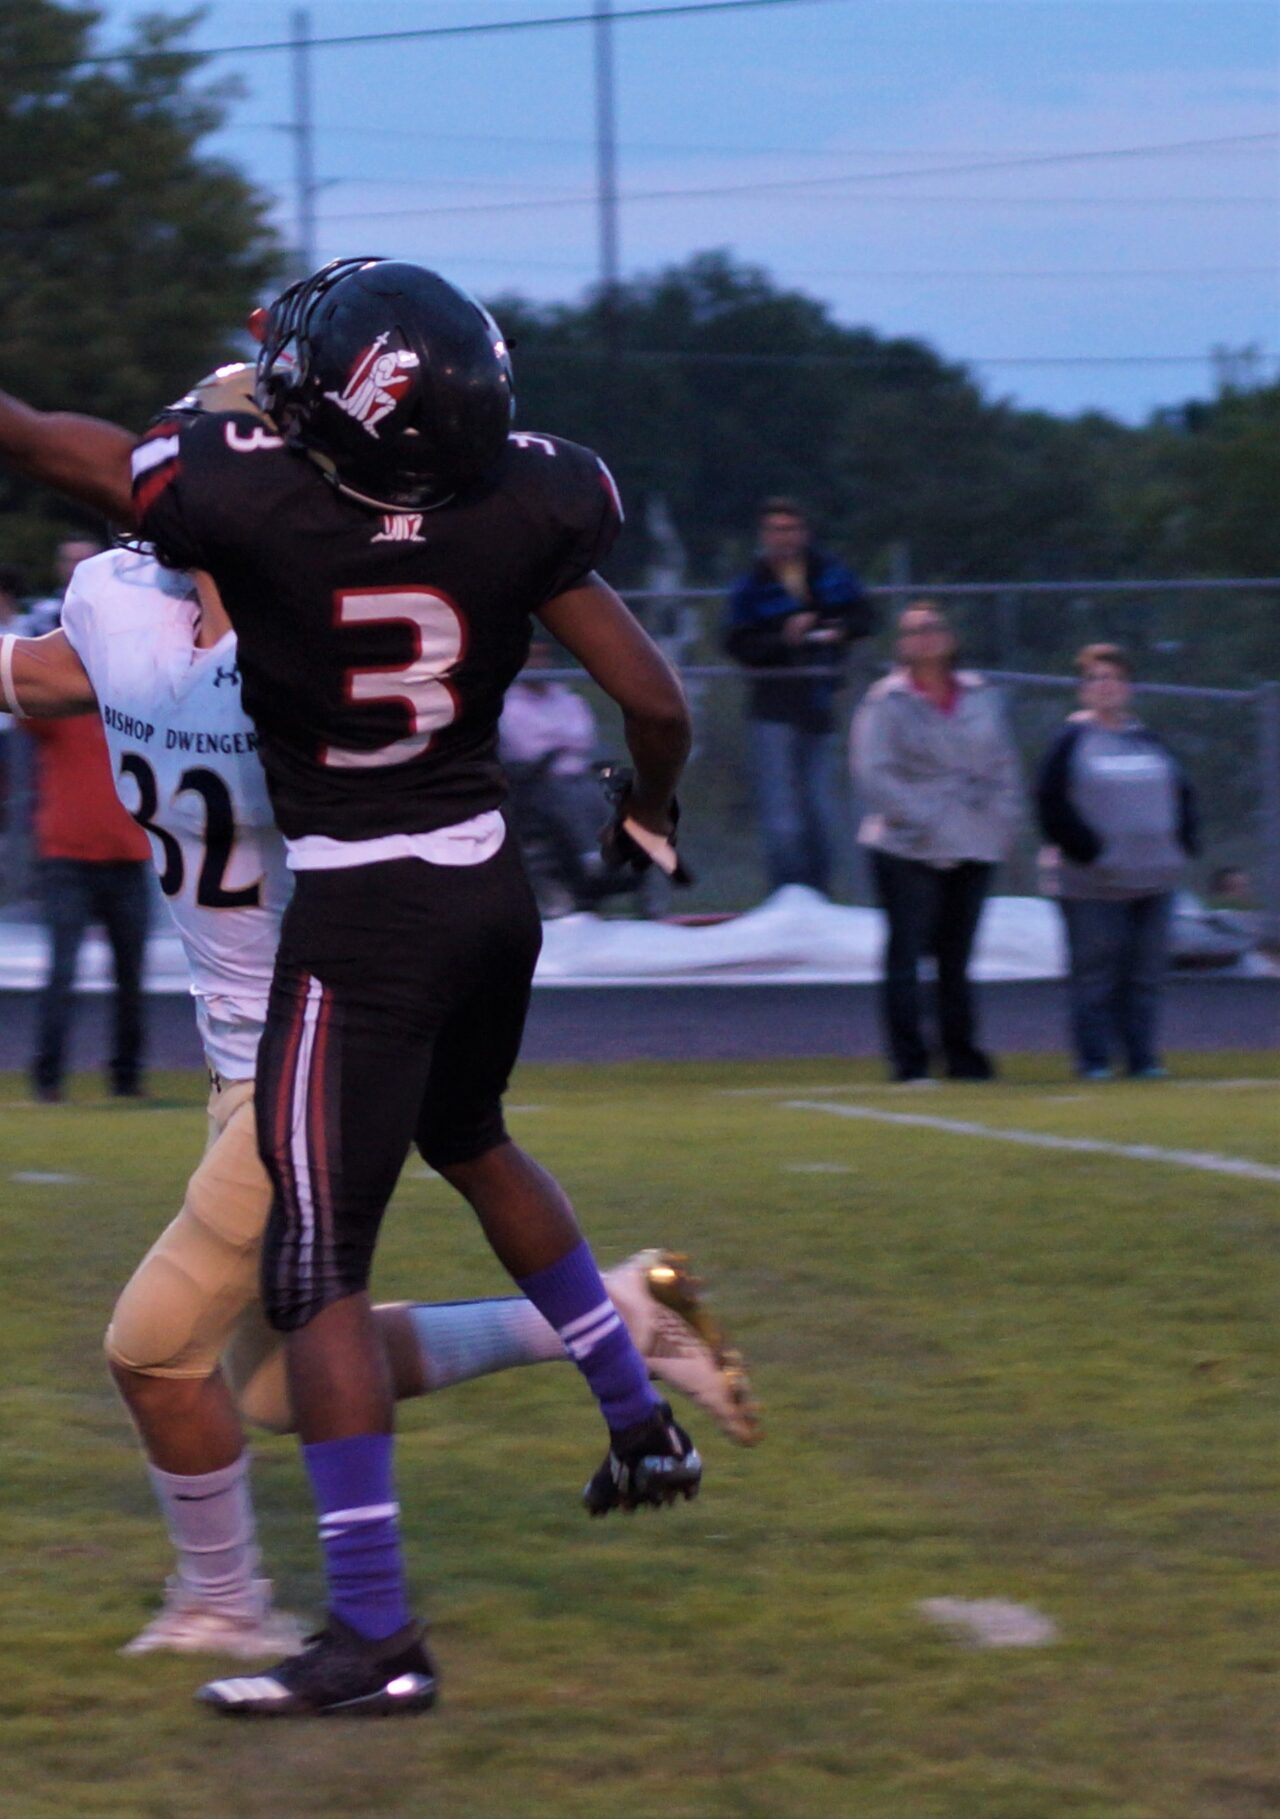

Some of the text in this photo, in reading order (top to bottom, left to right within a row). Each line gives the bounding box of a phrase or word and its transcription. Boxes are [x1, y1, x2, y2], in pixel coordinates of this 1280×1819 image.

[104, 706, 155, 743] BISHOP
[321, 584, 468, 768] 3
[120, 753, 265, 909] 32
